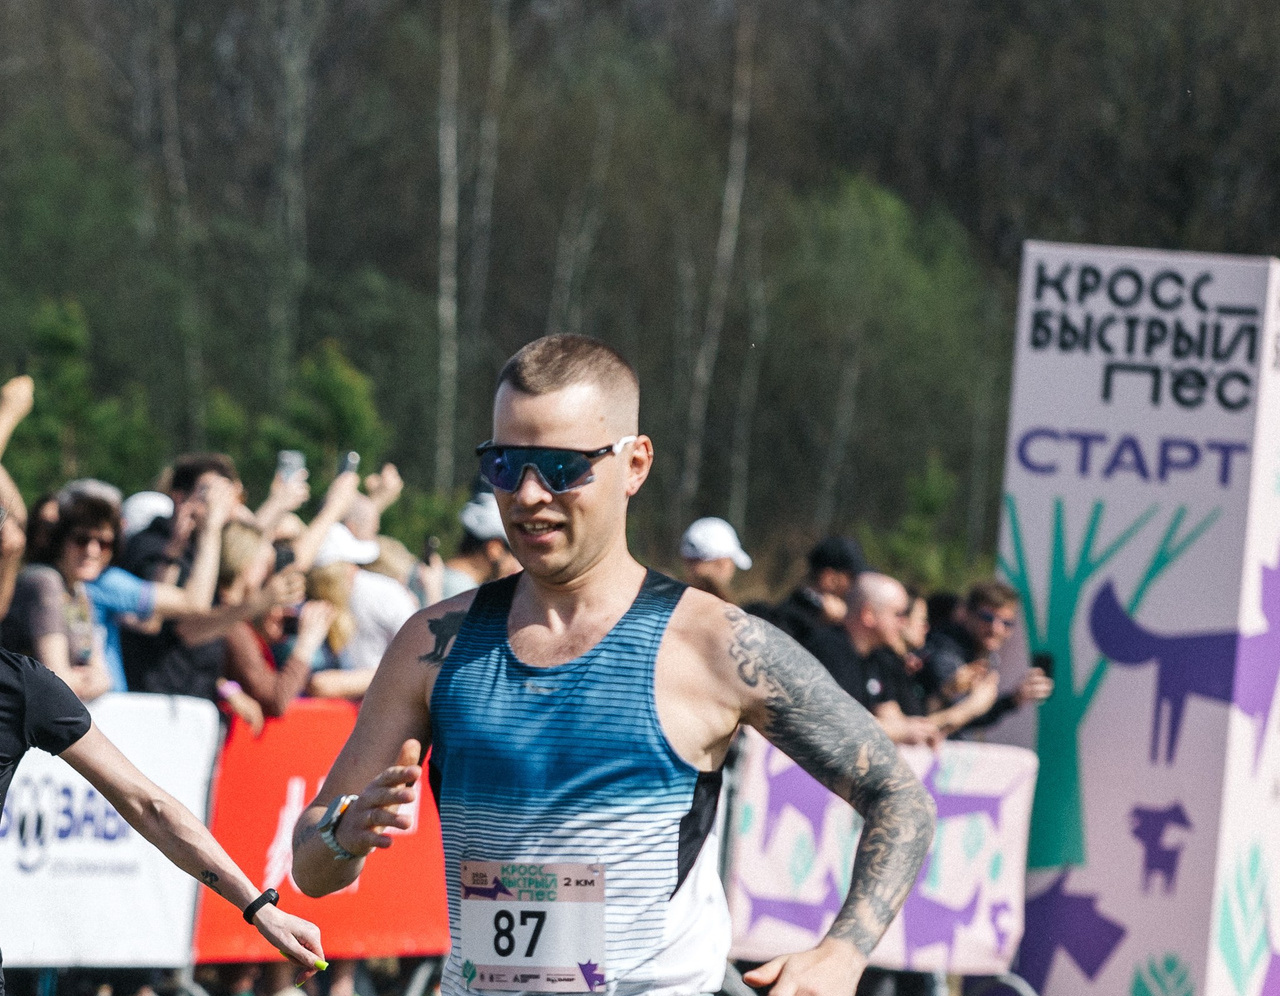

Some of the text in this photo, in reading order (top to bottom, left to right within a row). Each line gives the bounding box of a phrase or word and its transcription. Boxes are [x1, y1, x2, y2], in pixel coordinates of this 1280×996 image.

[1034, 261, 1213, 313] КРОСС
[1030, 308, 1258, 364] БЫСТРЫЙ
[1017, 427, 1250, 487] СТАРТ
[563, 877, 595, 887] 2 КМ
[493, 909, 547, 957] 87
